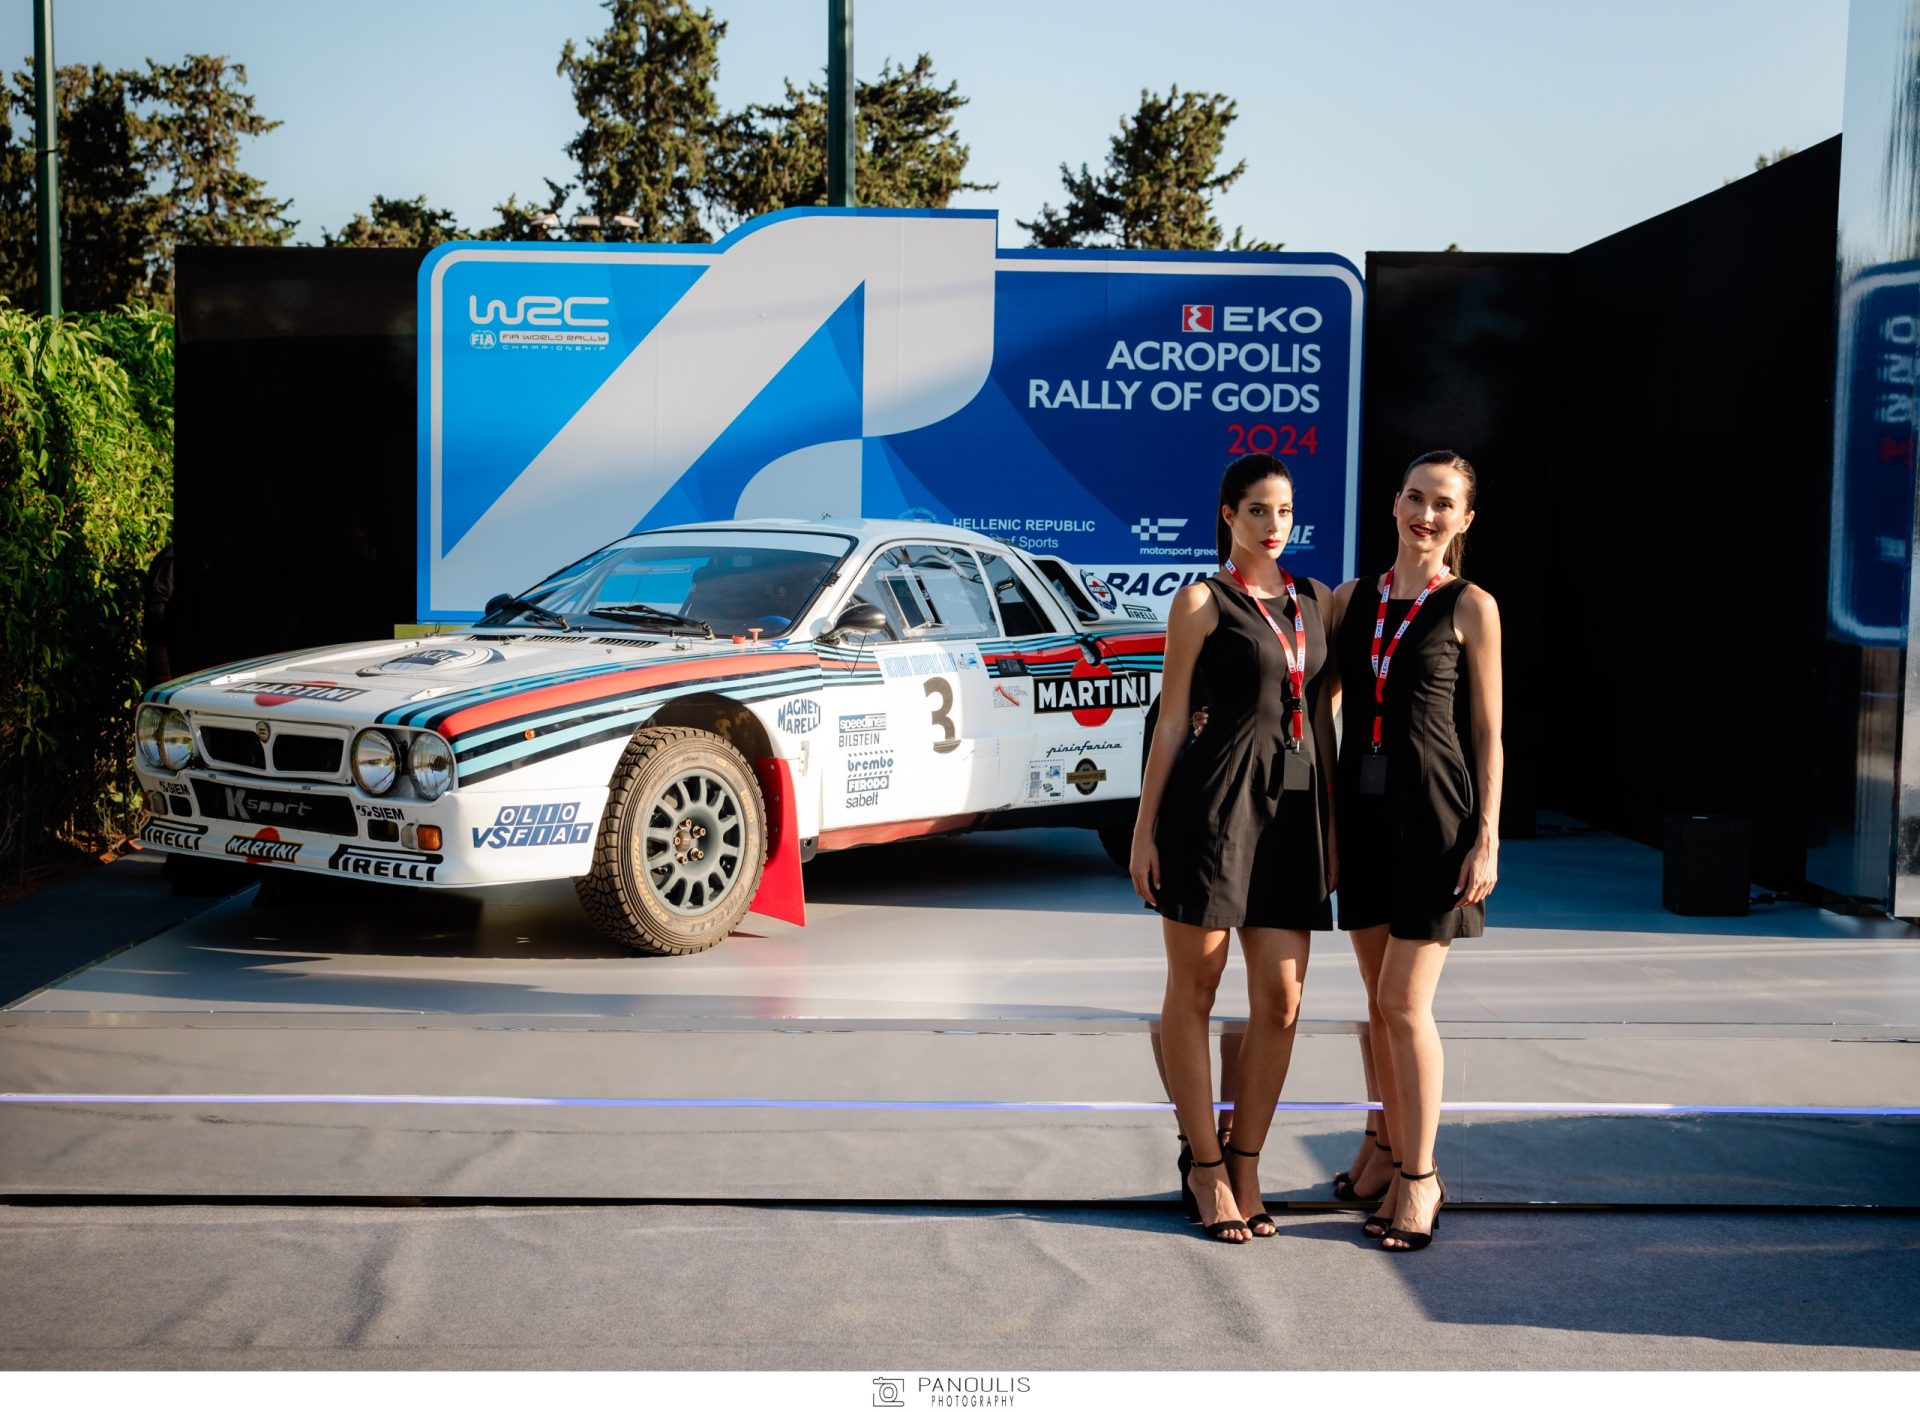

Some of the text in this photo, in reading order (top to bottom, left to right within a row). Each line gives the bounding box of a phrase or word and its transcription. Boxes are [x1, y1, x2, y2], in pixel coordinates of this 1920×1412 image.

[469, 295, 609, 326] WRC
[1223, 306, 1323, 333] EKO
[470, 332, 496, 347] FIA
[1106, 340, 1322, 373] ACROPOLIS
[1028, 378, 1321, 413] RALLY OF GODS
[1227, 423, 1319, 456] 2024
[953, 518, 1096, 532] HELLENIC REPUBLIC
[1019, 535, 1059, 550] Sports
[1139, 547, 1192, 557] motorsport
[1122, 603, 1158, 621] PIRELLI
[232, 682, 362, 701] MARTINI
[1038, 676, 1147, 709] MARTINI
[923, 676, 962, 755] 3
[839, 732, 880, 748] BILSTEIN
[1046, 740, 1122, 758] pininfarina
[847, 756, 894, 772] brembo
[168, 781, 191, 796] SIEM
[848, 777, 888, 793] FERODO
[846, 792, 879, 809] sabelt
[372, 806, 405, 820] SIEM
[500, 805, 576, 824] OLIO
[140, 816, 208, 850] PIRELLI
[228, 838, 299, 860] MARTINI
[329, 843, 444, 882] PIRELLI
